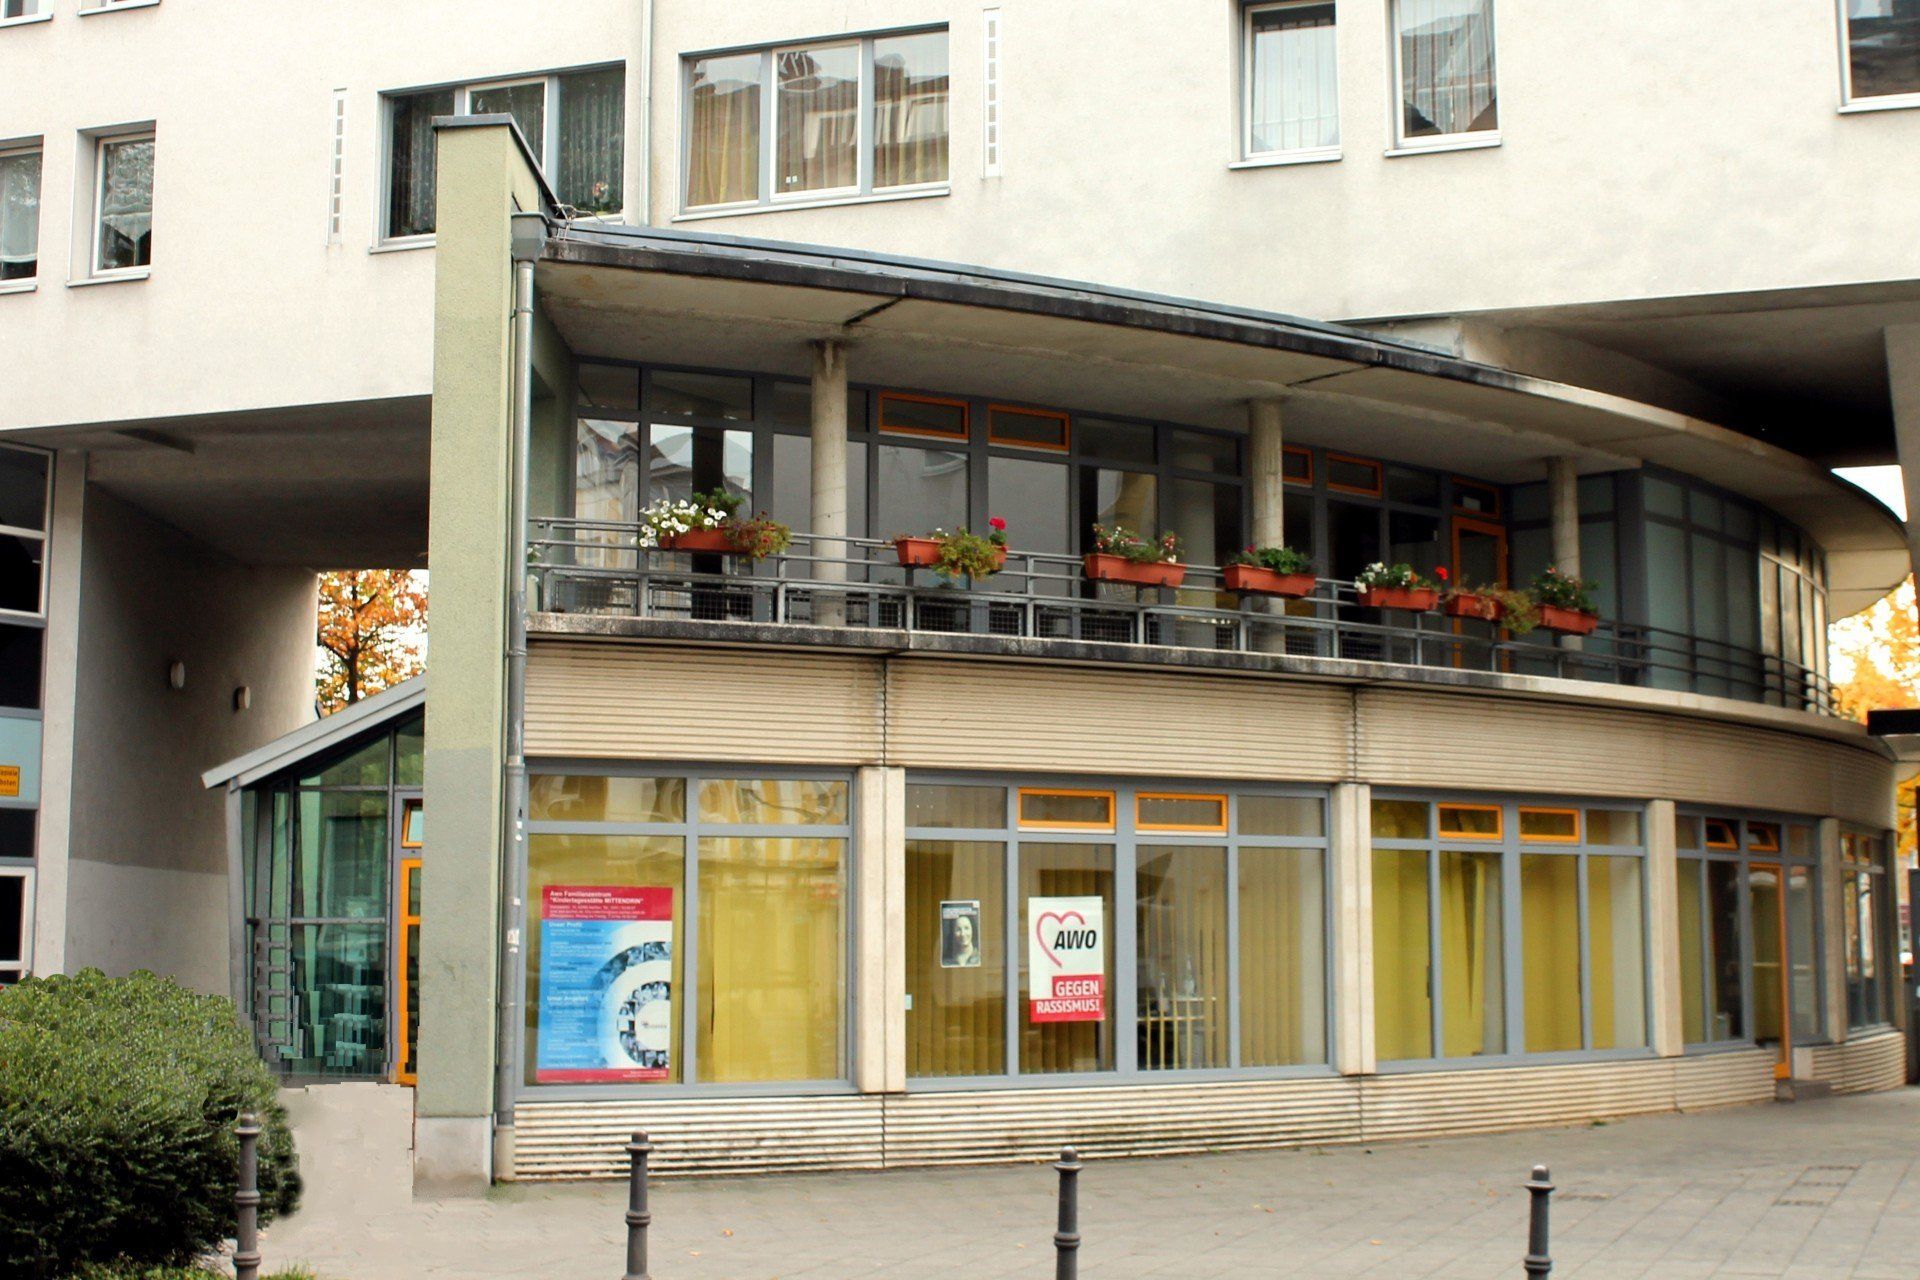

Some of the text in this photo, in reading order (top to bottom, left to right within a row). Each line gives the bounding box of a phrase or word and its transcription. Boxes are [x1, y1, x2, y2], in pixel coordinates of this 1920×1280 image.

[1054, 930, 1097, 950] AWO
[1055, 981, 1099, 996] GEGEN
[1036, 999, 1100, 1014] RASSISMUS!
